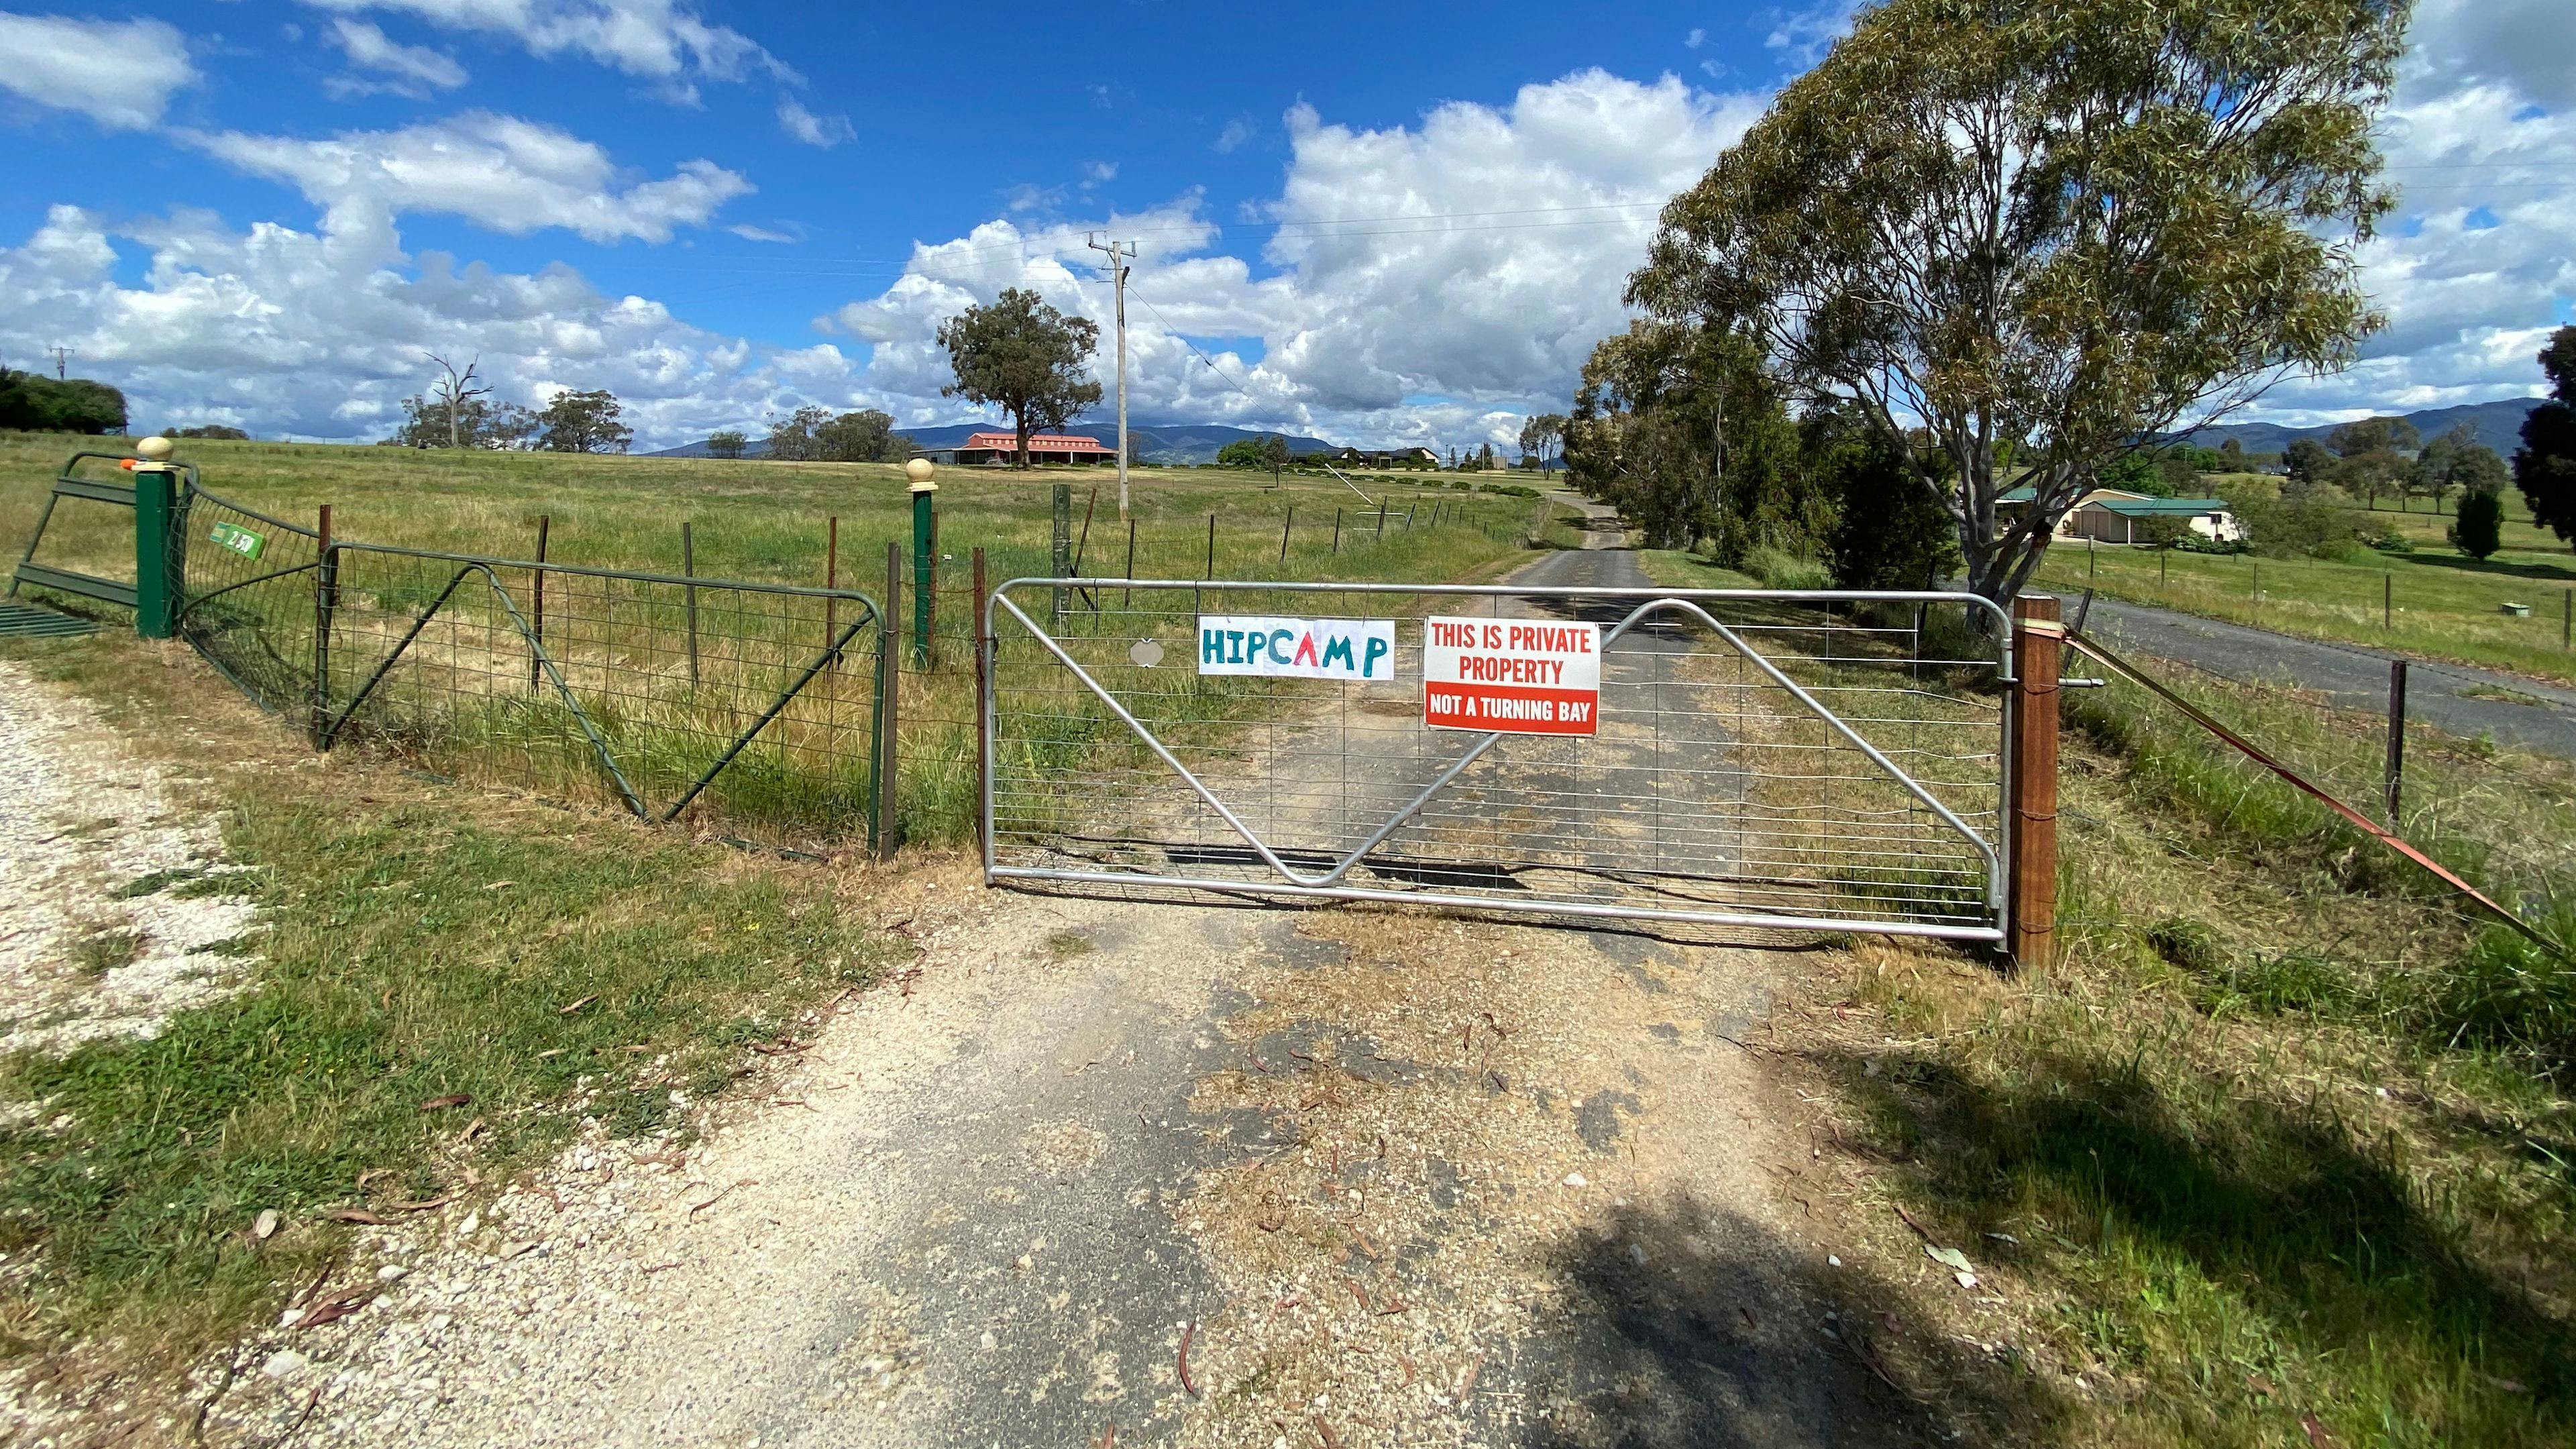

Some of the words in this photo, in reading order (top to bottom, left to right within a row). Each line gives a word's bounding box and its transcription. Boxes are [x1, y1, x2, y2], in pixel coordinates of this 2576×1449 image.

[1431, 623, 1475, 648] THIS
[1483, 625, 1502, 649] IS
[1509, 626, 1591, 653] PRIVATE
[1203, 629, 1387, 677] HIPCAMP
[1459, 656, 1564, 684] PROPERTY
[1430, 693, 1462, 715] NOT
[1465, 696, 1477, 717] A
[1480, 697, 1553, 722] TURNING
[1558, 702, 1591, 722] BAY
